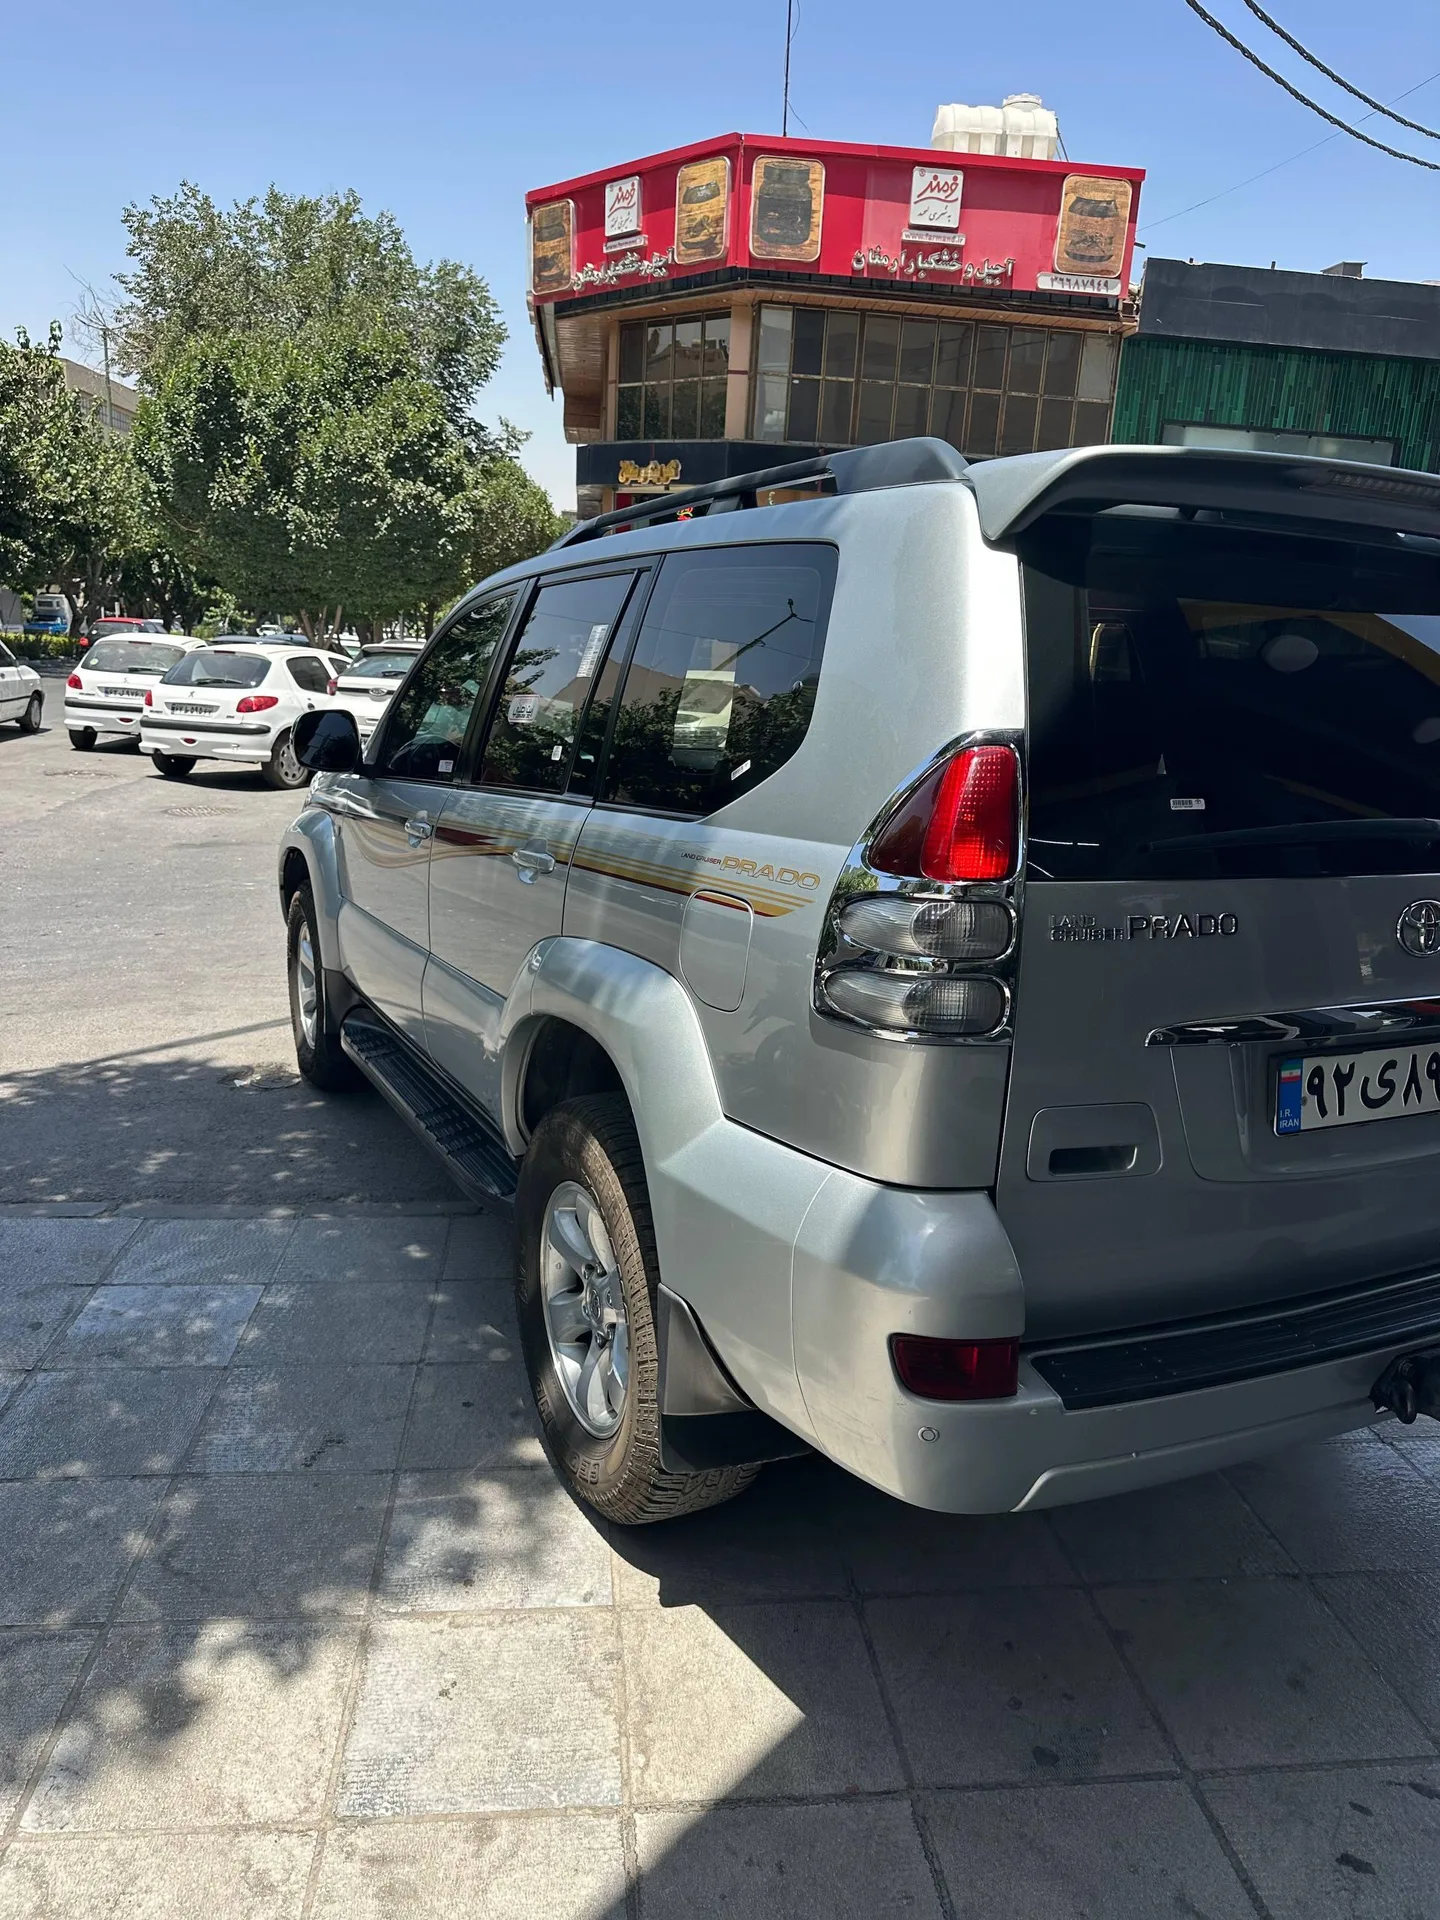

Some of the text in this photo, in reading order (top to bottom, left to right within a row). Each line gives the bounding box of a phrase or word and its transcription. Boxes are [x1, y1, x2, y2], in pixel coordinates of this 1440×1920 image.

[681, 852, 820, 890] LAND CRUISER PRADO
[1050, 915, 1096, 927] LAND
[1126, 912, 1238, 941] PRADO
[1279, 1118, 1299, 1129] IRAN
